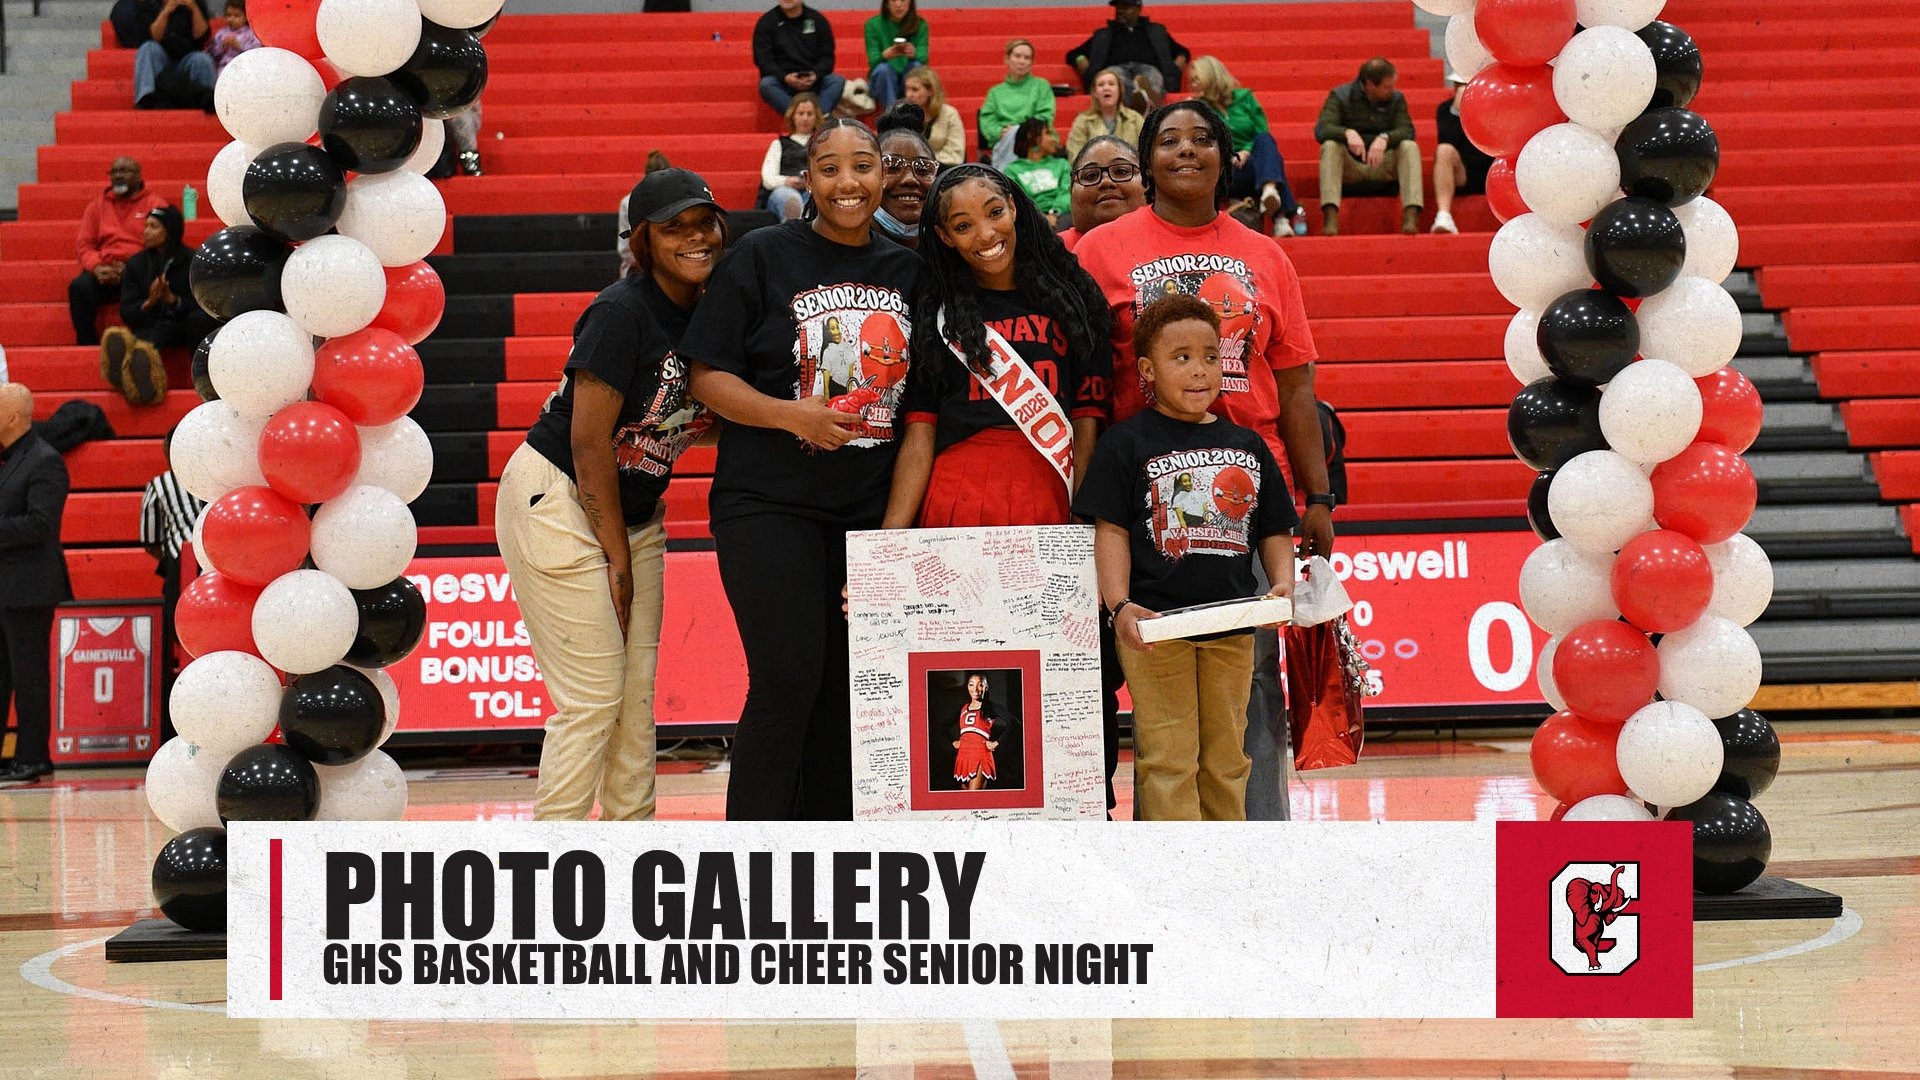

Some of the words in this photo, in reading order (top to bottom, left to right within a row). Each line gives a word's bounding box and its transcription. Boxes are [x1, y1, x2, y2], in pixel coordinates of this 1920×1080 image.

[1014, 392, 1050, 425] 2026
[1353, 600, 1374, 627] 0
[73, 648, 136, 664] GAINESVILLE
[1467, 600, 1535, 693] 0
[94, 667, 114, 704] 0
[468, 690, 542, 719] TOL:
